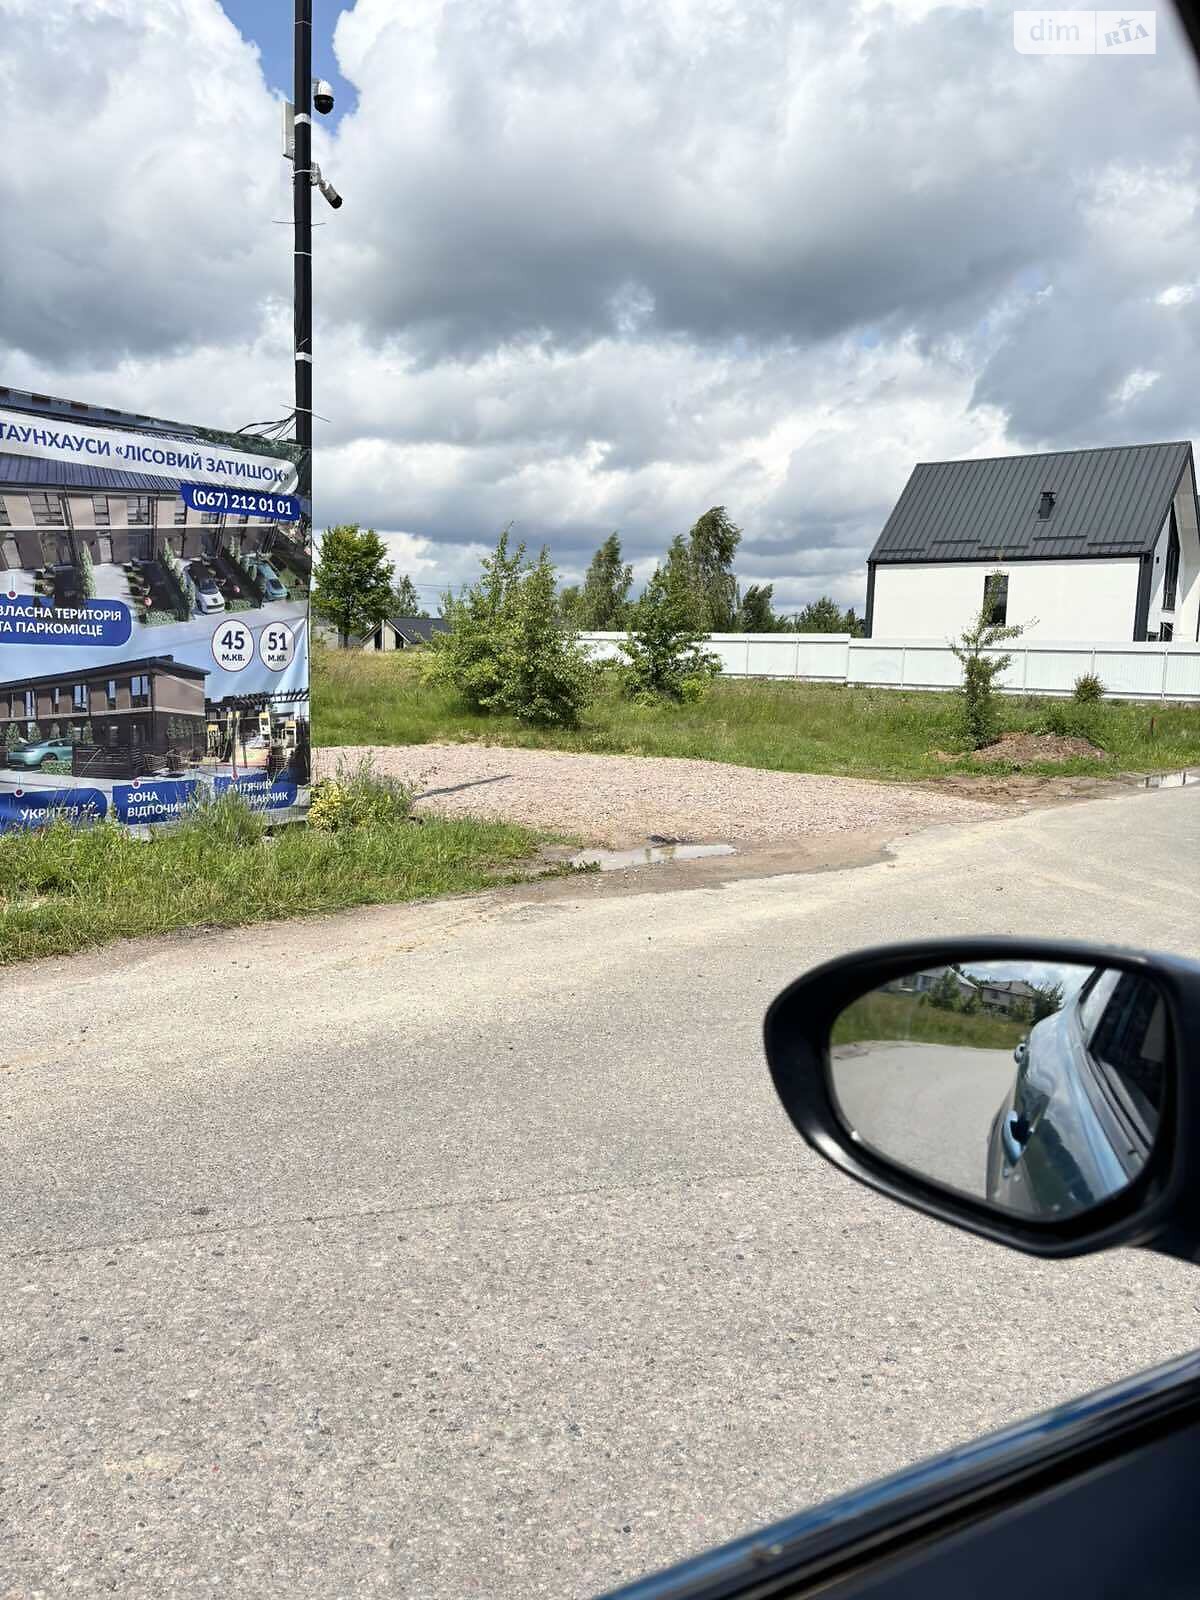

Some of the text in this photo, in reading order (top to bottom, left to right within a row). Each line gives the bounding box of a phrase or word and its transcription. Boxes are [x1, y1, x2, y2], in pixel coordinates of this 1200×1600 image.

[0, 422, 110, 457] ТАУНХАУСИ
[115, 444, 202, 471] «ЛІСОВИЙ
[193, 490, 292, 515] (067) 212 01 01
[54, 607, 122, 622] ТЕРИТОРІЯ
[16, 621, 103, 637] ПАРКОМІСЦЕ
[221, 630, 245, 650] 45
[267, 632, 288, 651] 51
[127, 791, 159, 803] ЗОНА
